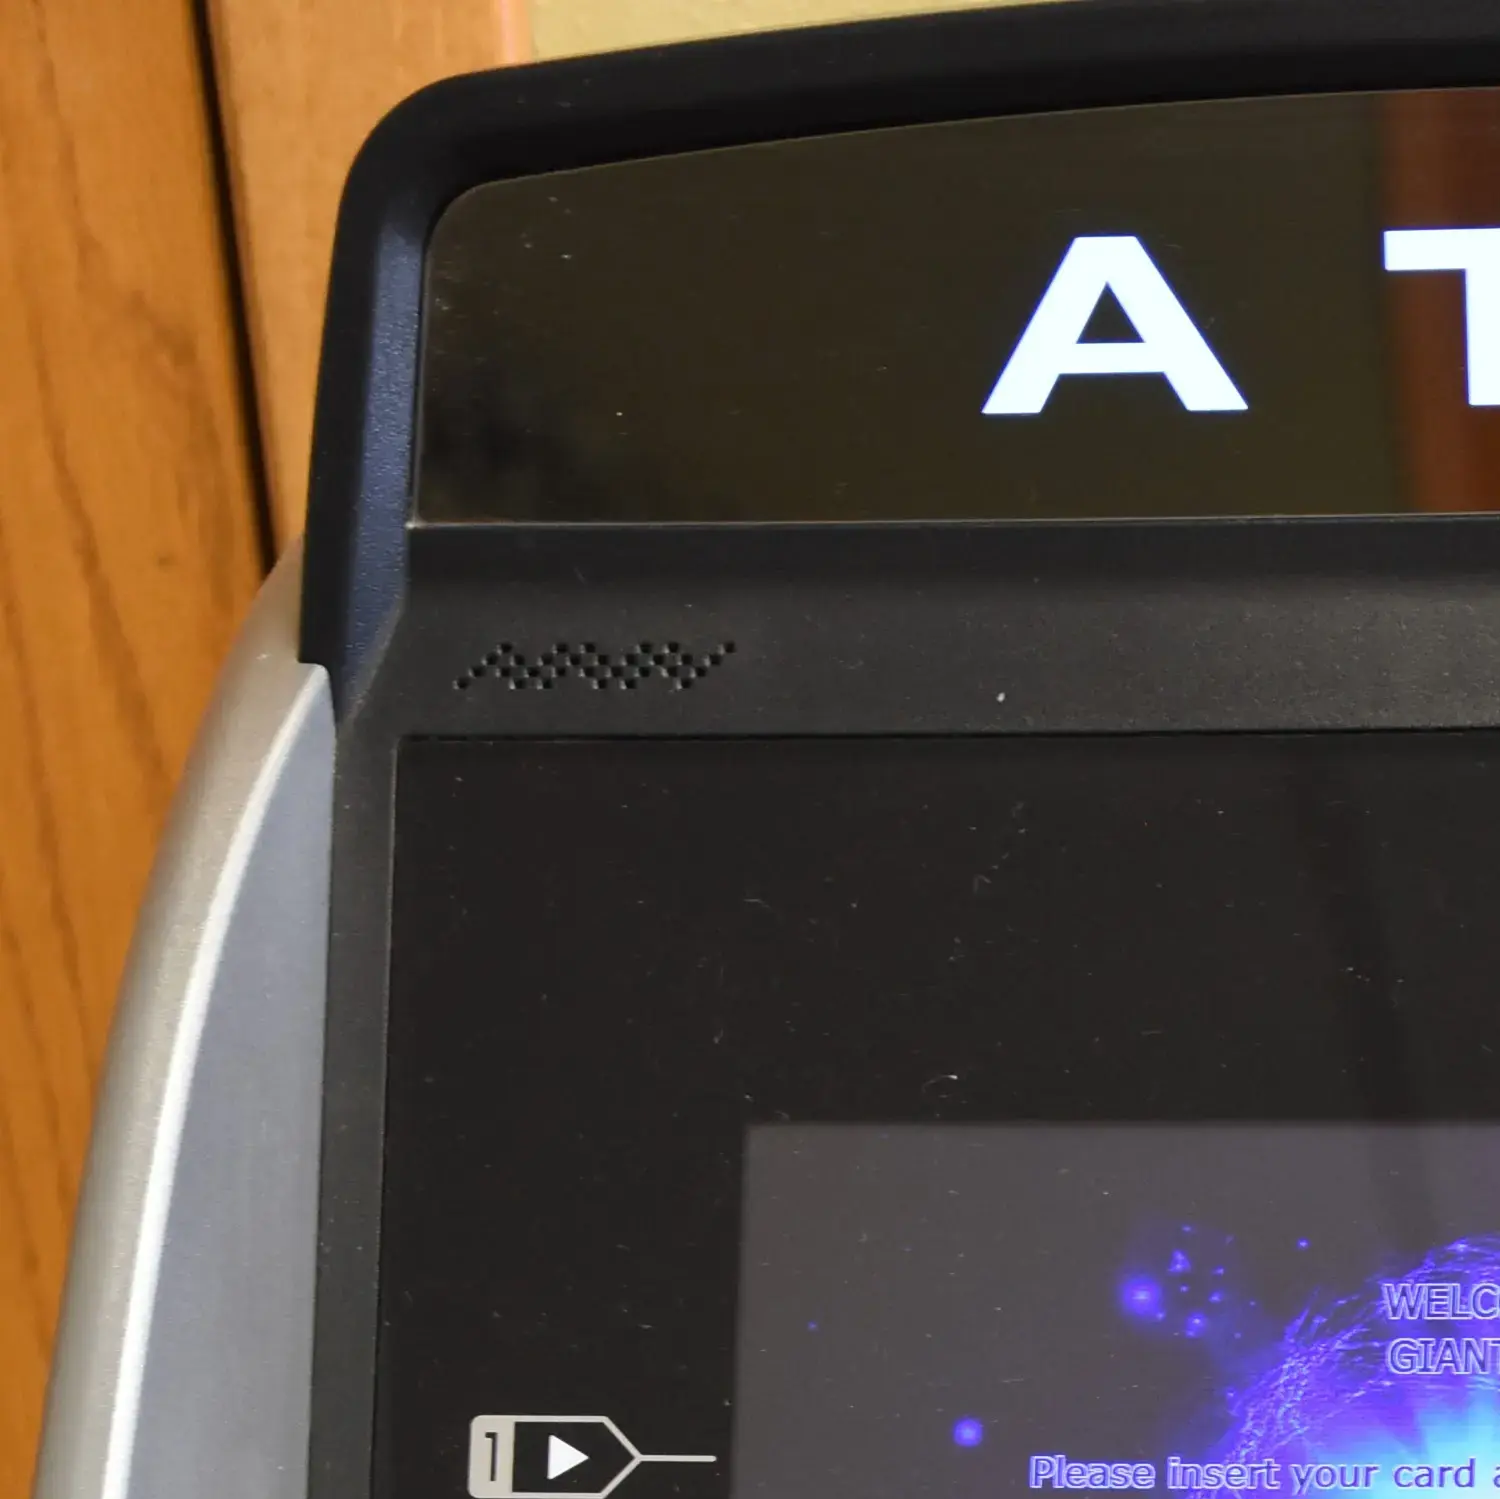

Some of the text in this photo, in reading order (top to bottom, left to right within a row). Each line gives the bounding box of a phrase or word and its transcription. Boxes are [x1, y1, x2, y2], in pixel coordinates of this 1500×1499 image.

[484, 1431, 498, 1482] 1
[1028, 1454, 1156, 1489] Please
[1166, 1456, 1281, 1490] insert
[1291, 1461, 1380, 1495] your
[1392, 1457, 1476, 1489] card
